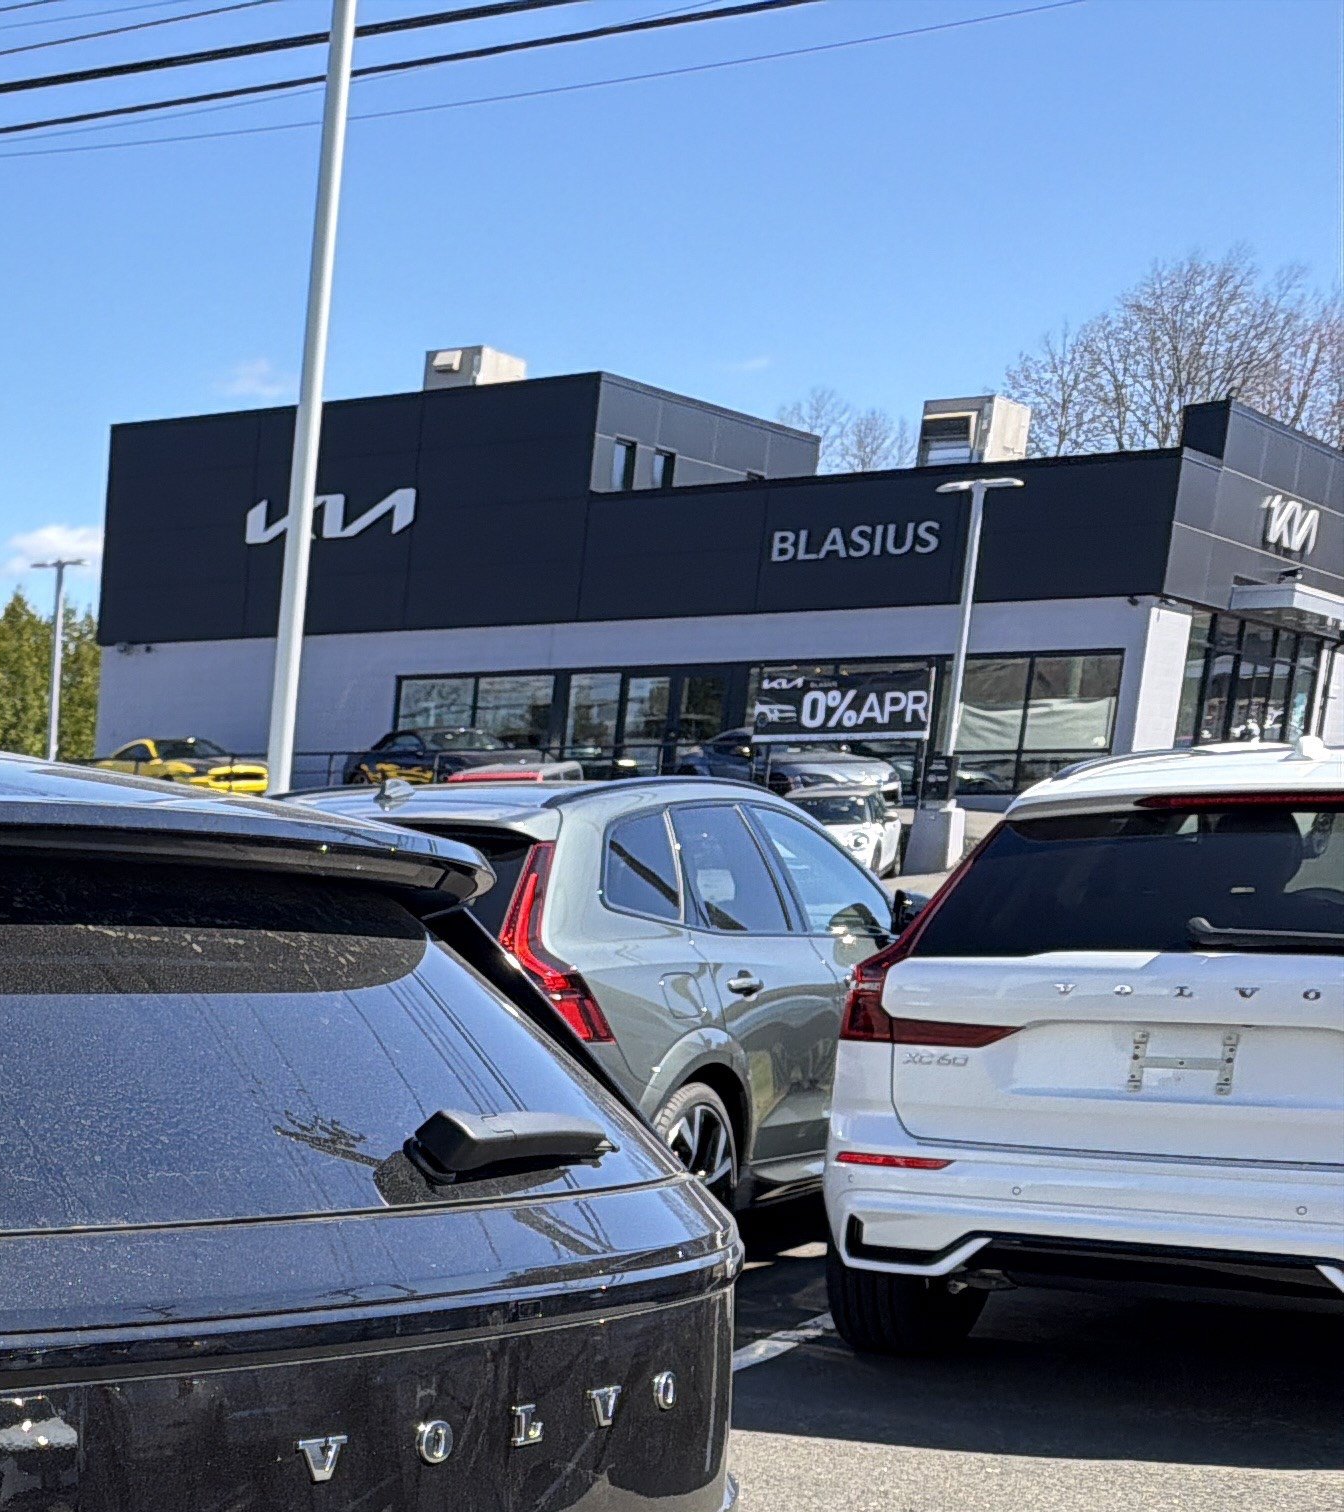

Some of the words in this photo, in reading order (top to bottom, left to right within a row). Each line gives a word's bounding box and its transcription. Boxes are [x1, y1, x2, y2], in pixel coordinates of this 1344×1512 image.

[770, 520, 940, 562] BLASIUS
[1053, 983, 1322, 1001] VOLVO
[294, 1370, 677, 1482] VOLVO
